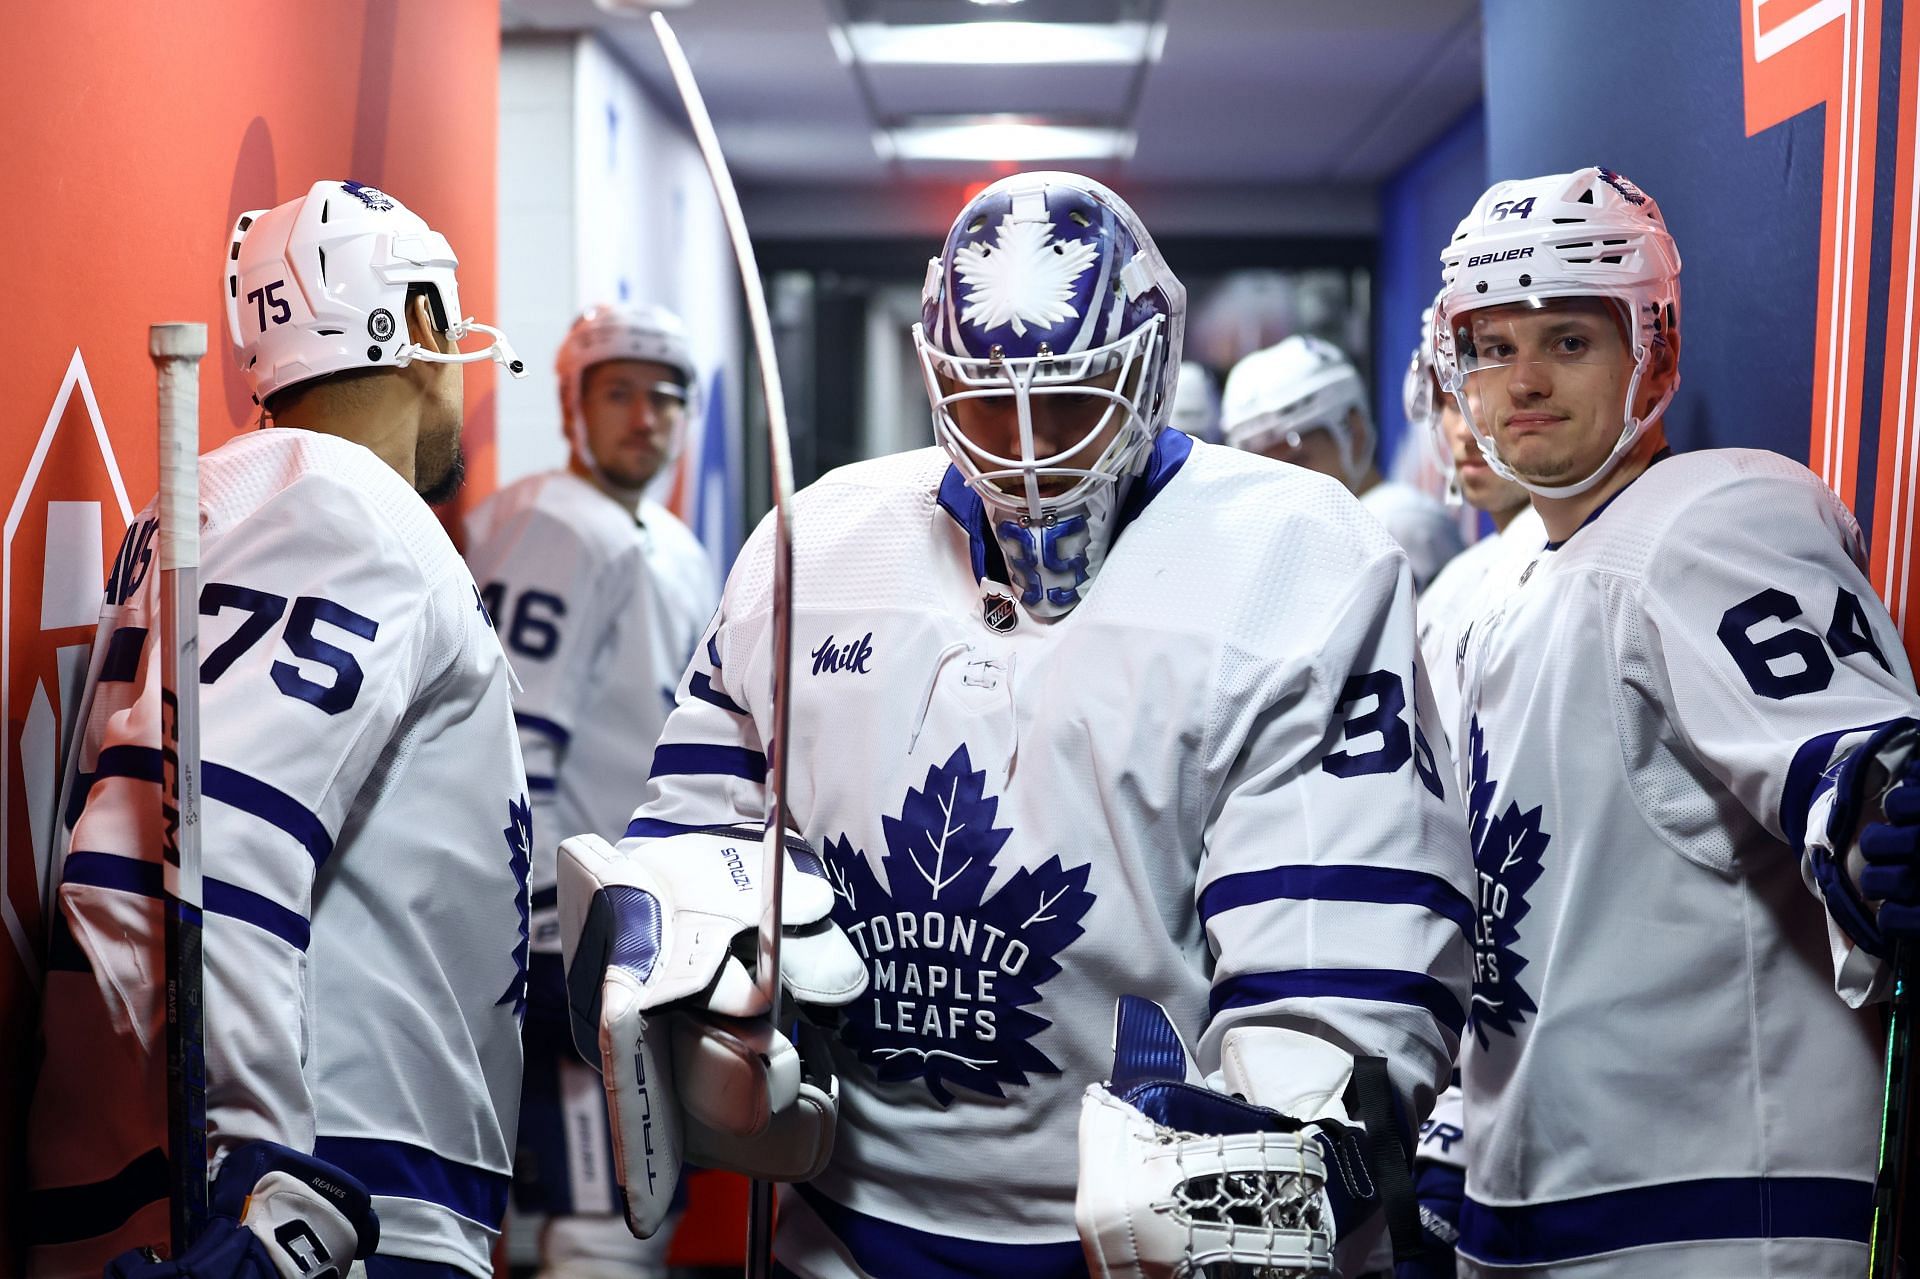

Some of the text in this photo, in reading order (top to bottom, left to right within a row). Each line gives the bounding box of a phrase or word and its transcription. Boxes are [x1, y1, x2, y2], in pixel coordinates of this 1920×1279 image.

[1490, 197, 1538, 221] 64
[1468, 247, 1534, 268] BAUER
[247, 280, 291, 332] 75
[996, 515, 1090, 607] 35
[199, 583, 379, 716] 75
[811, 632, 873, 676] Milk
[1717, 586, 1898, 700] 64
[161, 687, 180, 869] CCM
[721, 847, 753, 892] HZRDUS
[1474, 868, 1509, 919] TO
[847, 911, 1030, 976] TORONTO
[874, 958, 998, 1003] MAPLE
[1473, 952, 1500, 984] FS
[168, 979, 177, 1024] REAVES
[873, 998, 997, 1042] LEAFS
[634, 1053, 657, 1197] TRUE
[311, 1177, 346, 1199] REAVES
